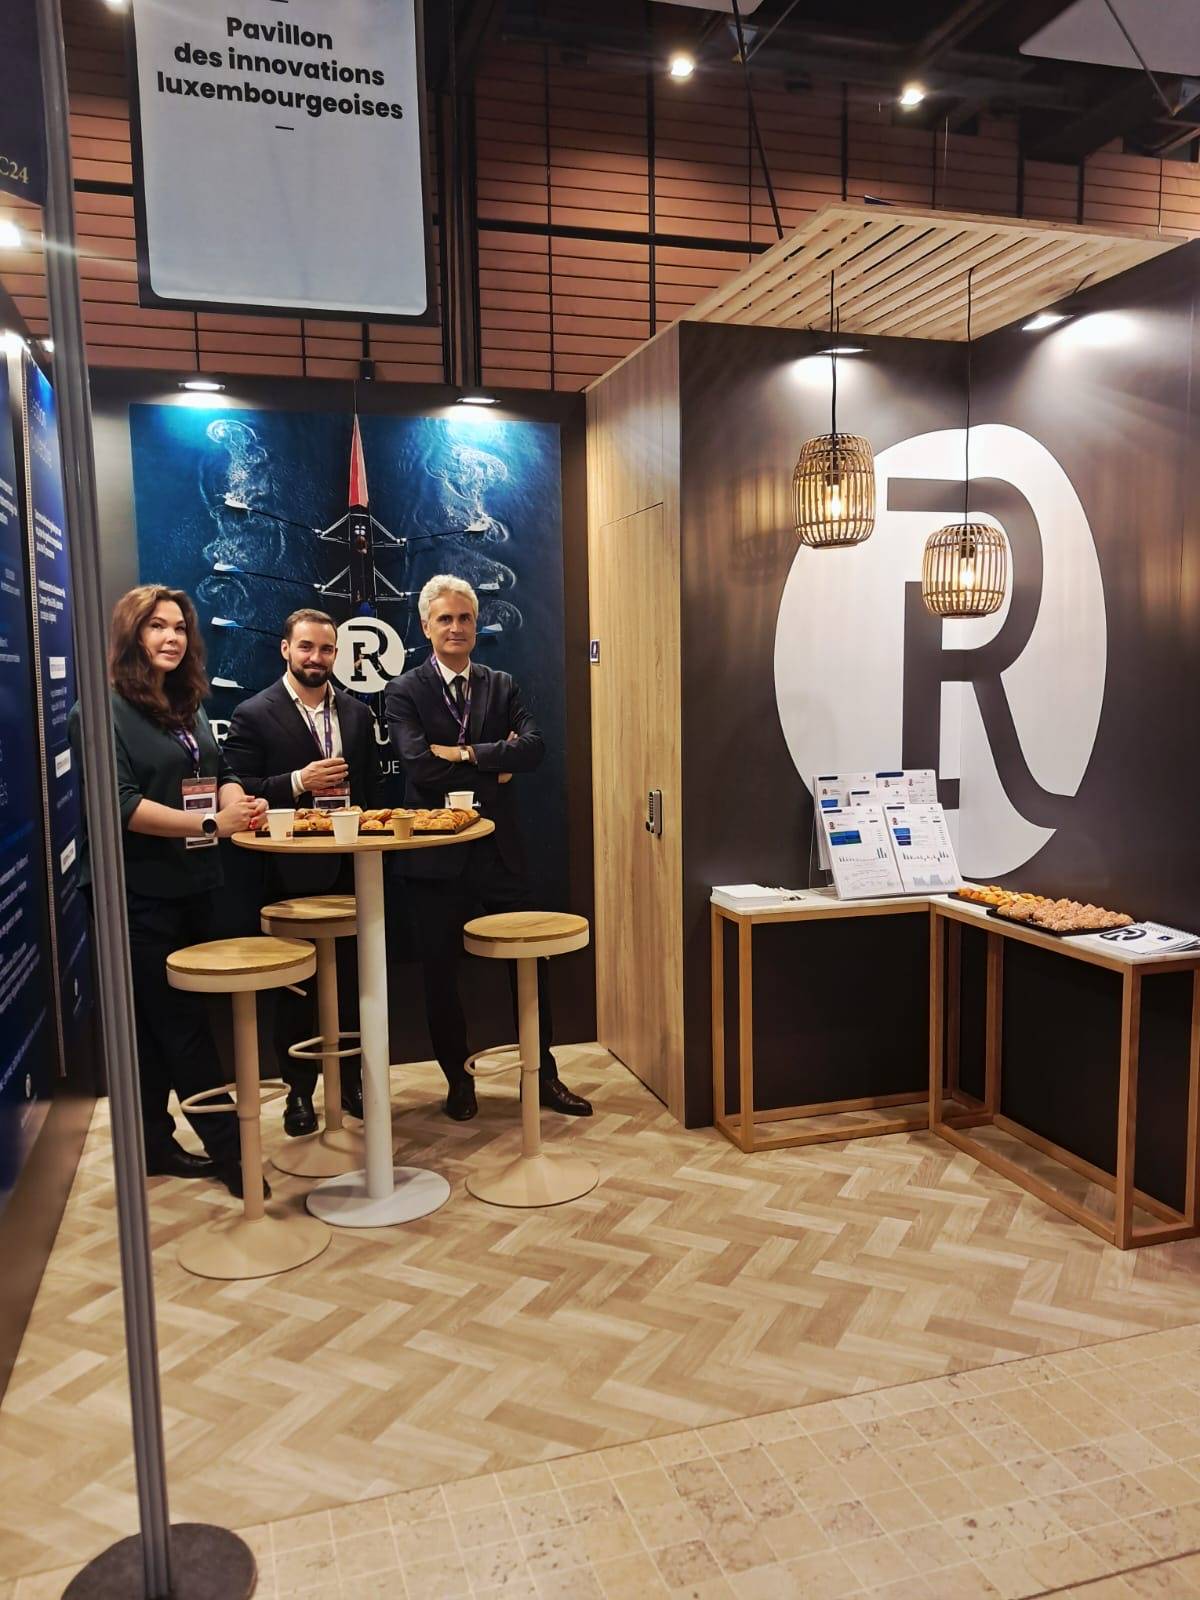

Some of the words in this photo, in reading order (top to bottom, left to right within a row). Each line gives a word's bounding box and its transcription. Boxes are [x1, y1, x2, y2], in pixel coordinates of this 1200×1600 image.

[226, 16, 334, 50] Pavillon
[174, 42, 223, 69] des
[228, 47, 386, 87] innovations
[156, 71, 404, 120] luxembourgeoises
[347, 624, 404, 683] R
